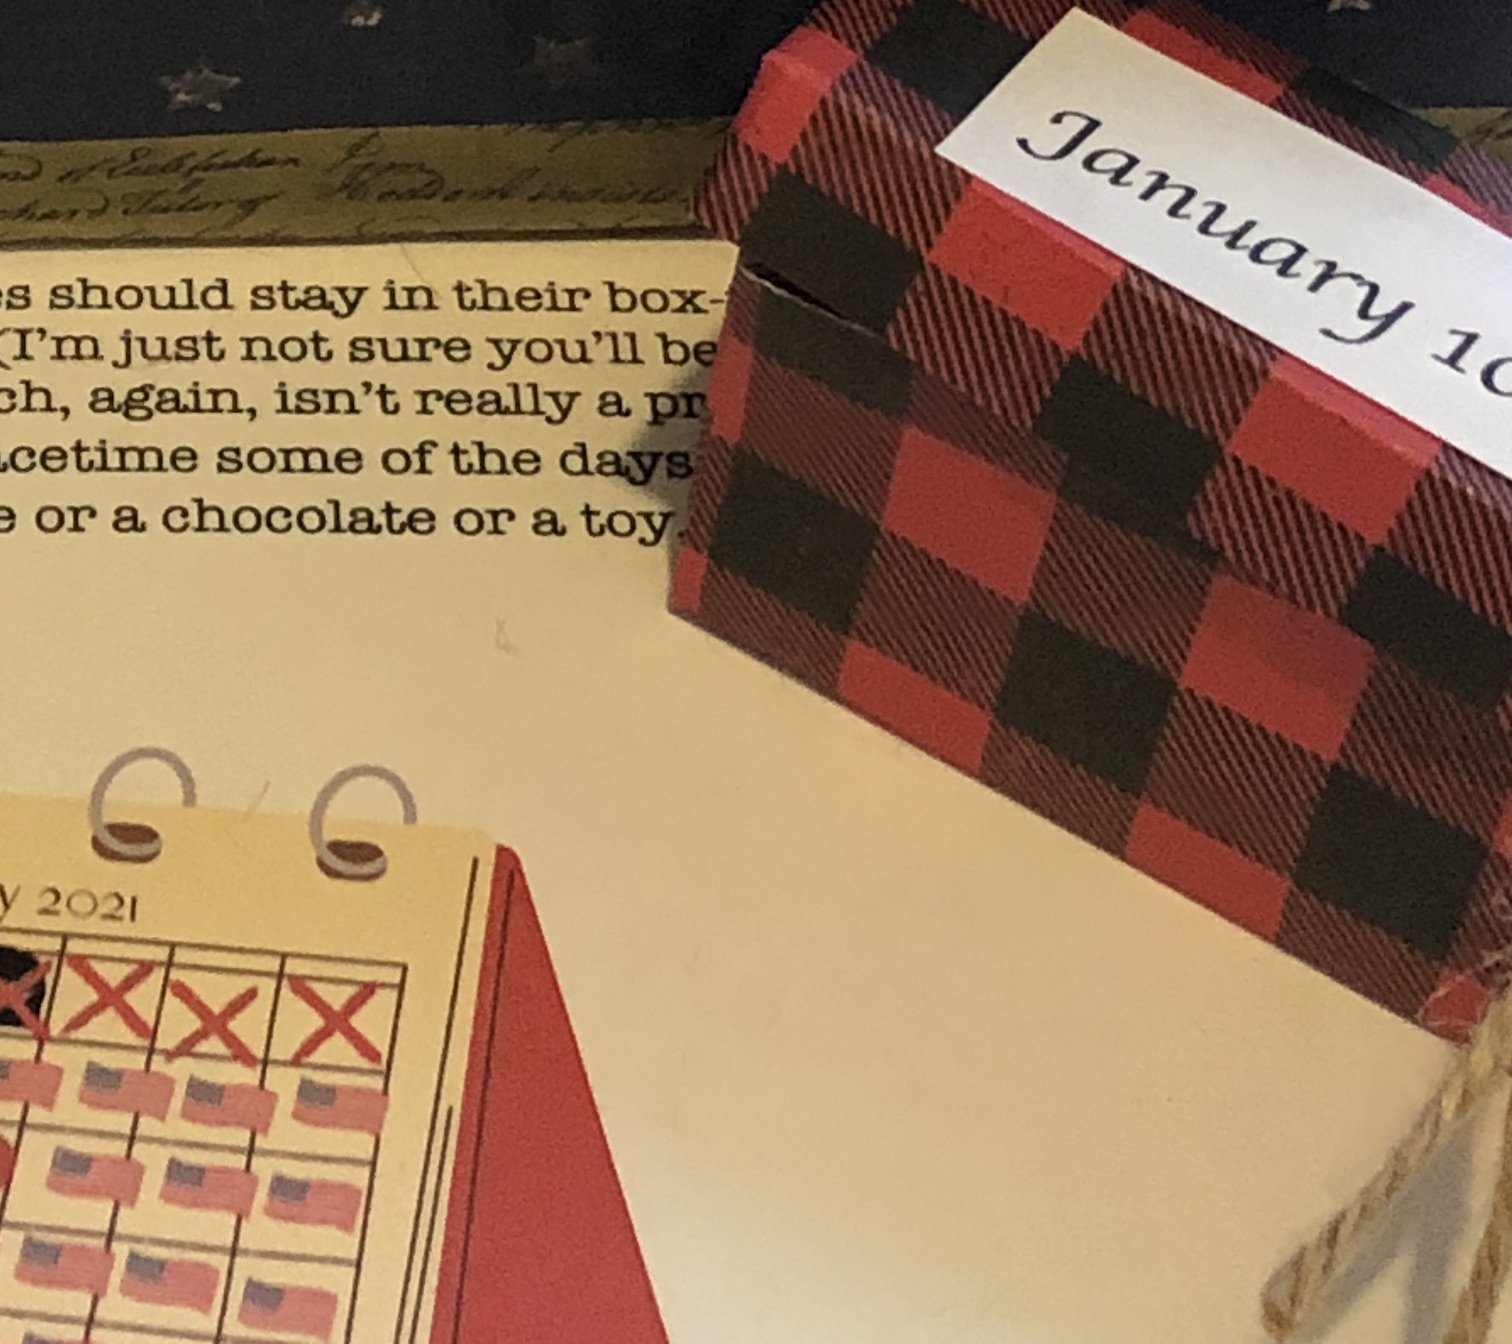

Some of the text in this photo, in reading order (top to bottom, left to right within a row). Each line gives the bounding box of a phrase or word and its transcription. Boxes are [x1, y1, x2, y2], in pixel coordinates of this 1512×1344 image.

[1015, 109, 1416, 345] January
[48, 276, 235, 311] should
[250, 279, 370, 320] stay
[382, 278, 440, 312] in
[451, 278, 592, 313] their
[111, 328, 226, 370] just
[238, 329, 334, 363] not
[348, 336, 472, 364] sure
[655, 331, 718, 367] be
[88, 380, 258, 422] again,
[413, 381, 583, 426] really
[596, 390, 633, 418] a
[216, 446, 364, 475] some
[380, 439, 439, 476] of
[447, 440, 542, 477] the
[559, 440, 694, 487] days
[35, 504, 98, 534] or
[111, 505, 147, 534] a
[161, 497, 437, 536] chocolate
[453, 507, 516, 537] or
[531, 507, 568, 538] a
[36, 886, 138, 923] 2021
